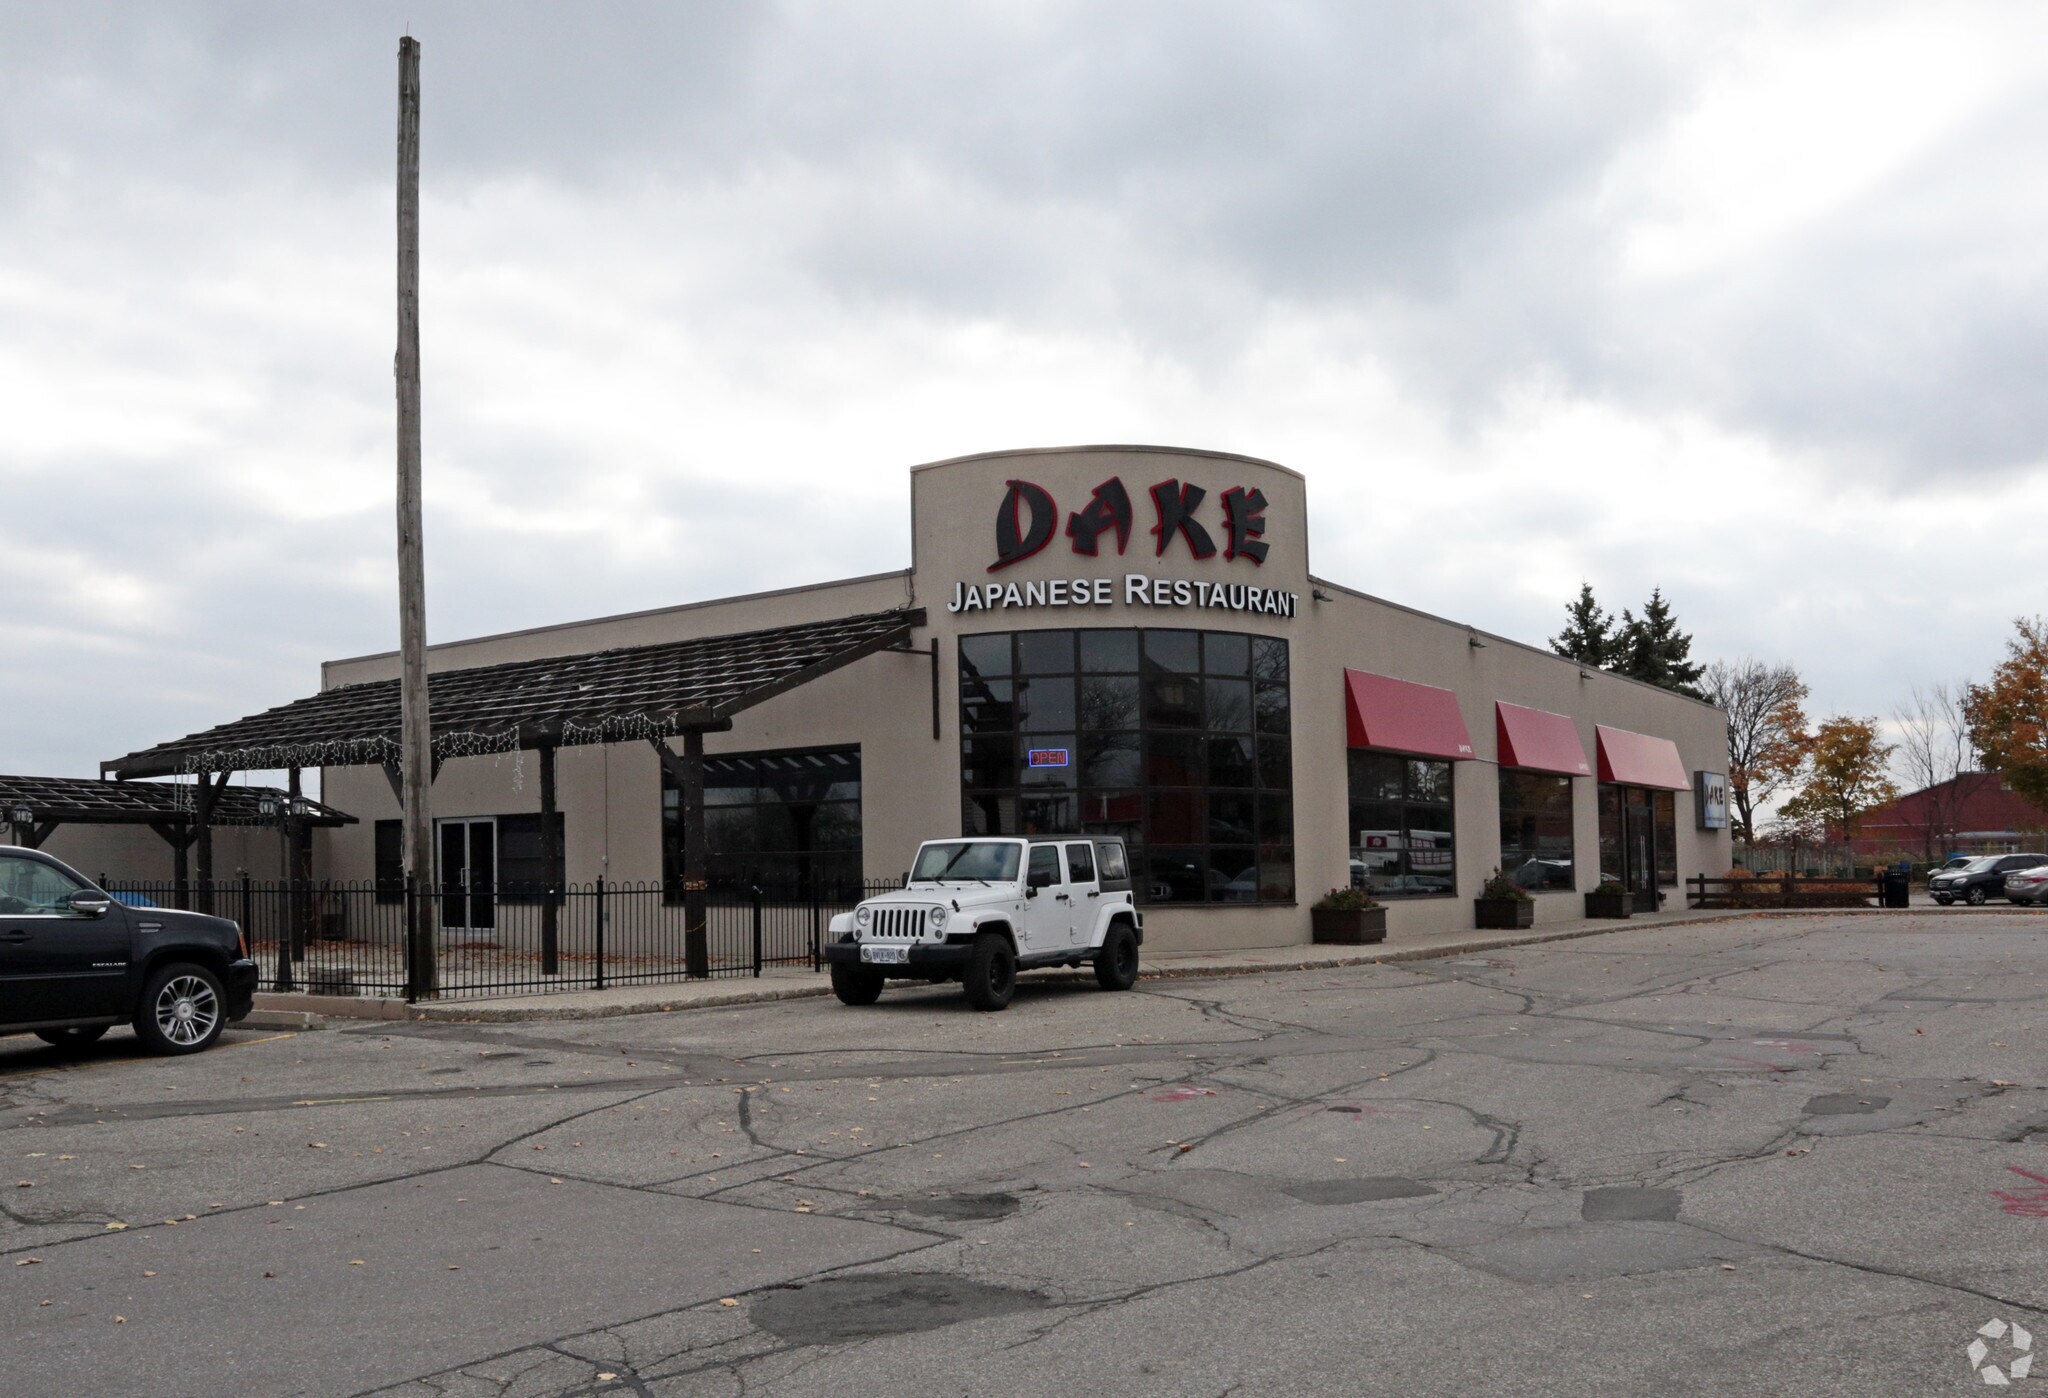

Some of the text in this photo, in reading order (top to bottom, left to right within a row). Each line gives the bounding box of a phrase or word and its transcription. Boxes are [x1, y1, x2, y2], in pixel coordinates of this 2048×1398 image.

[986, 475, 1270, 573] DAKE
[946, 574, 1300, 618] JAPANESE RESTAURANT
[1031, 751, 1066, 764] OPEN
